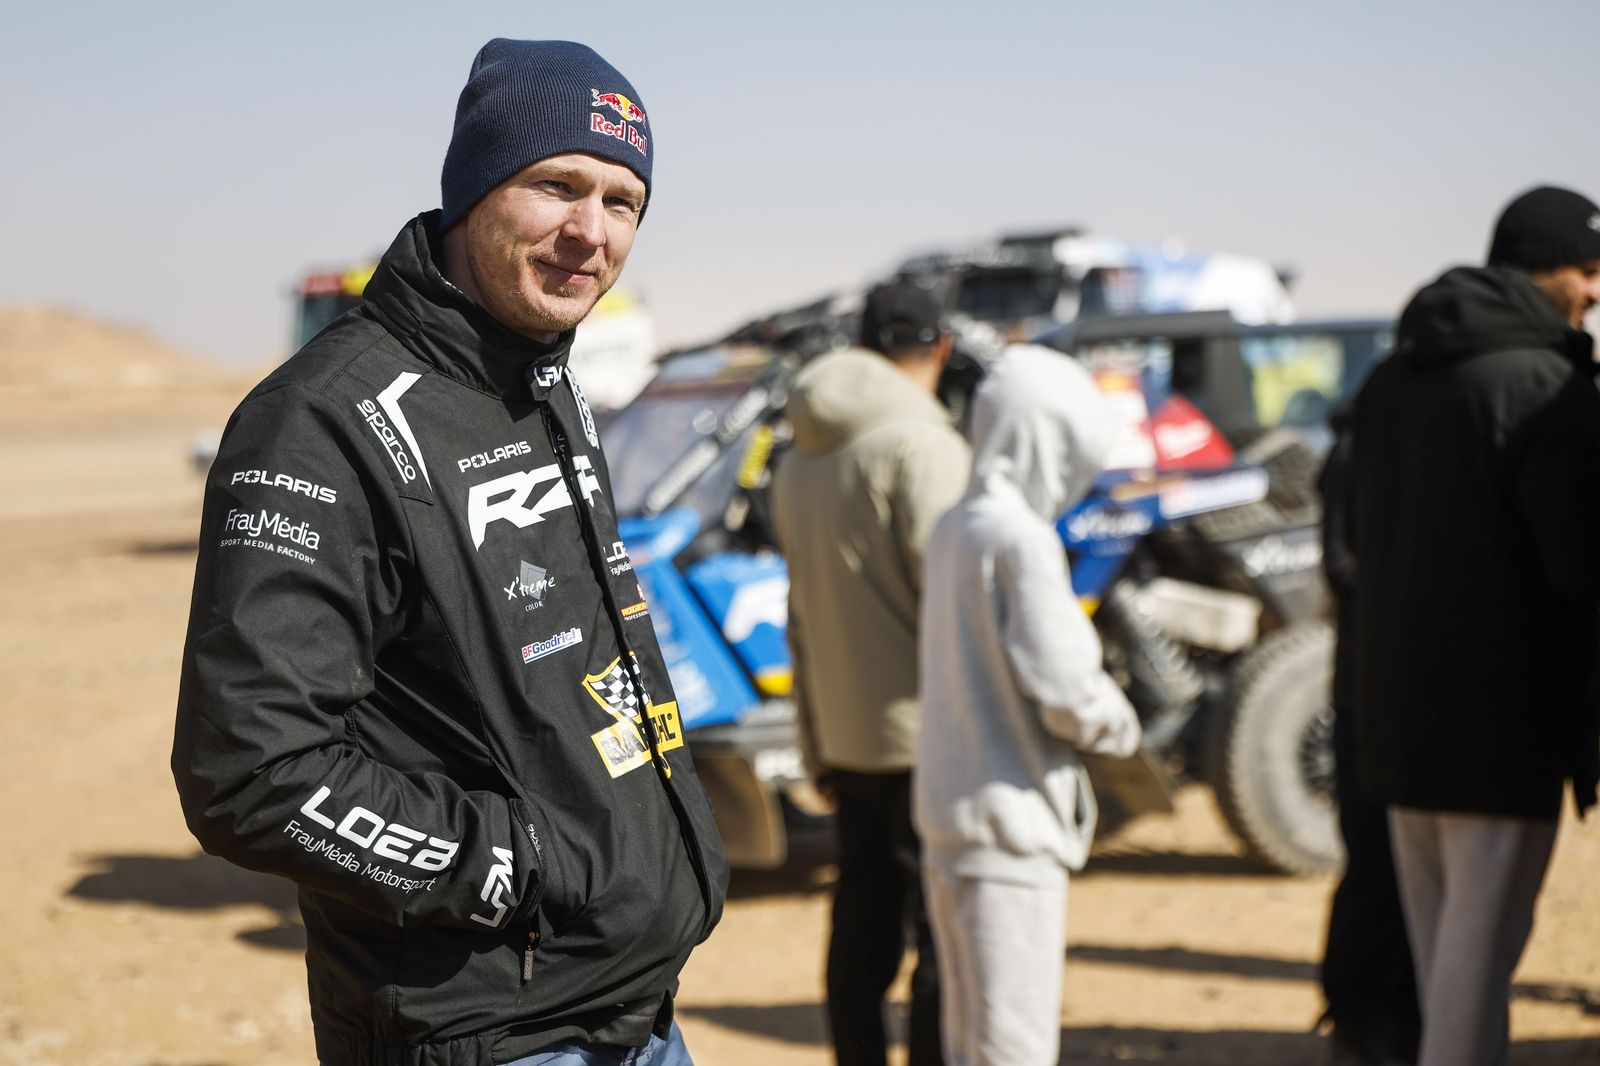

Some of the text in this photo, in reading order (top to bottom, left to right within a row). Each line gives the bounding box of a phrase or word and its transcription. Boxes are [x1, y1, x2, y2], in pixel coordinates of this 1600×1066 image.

[591, 113, 648, 156] Red Bull
[358, 399, 416, 482] sparco
[457, 441, 532, 473] POLARIS
[231, 470, 337, 503] POLARIS
[225, 509, 320, 550] FrayMédia
[220, 539, 316, 565] SPORT MEDIA FACTORY
[504, 577, 556, 600] X'treme
[525, 601, 544, 612] COLOR
[283, 820, 437, 894] FrayMédia Motorsport
